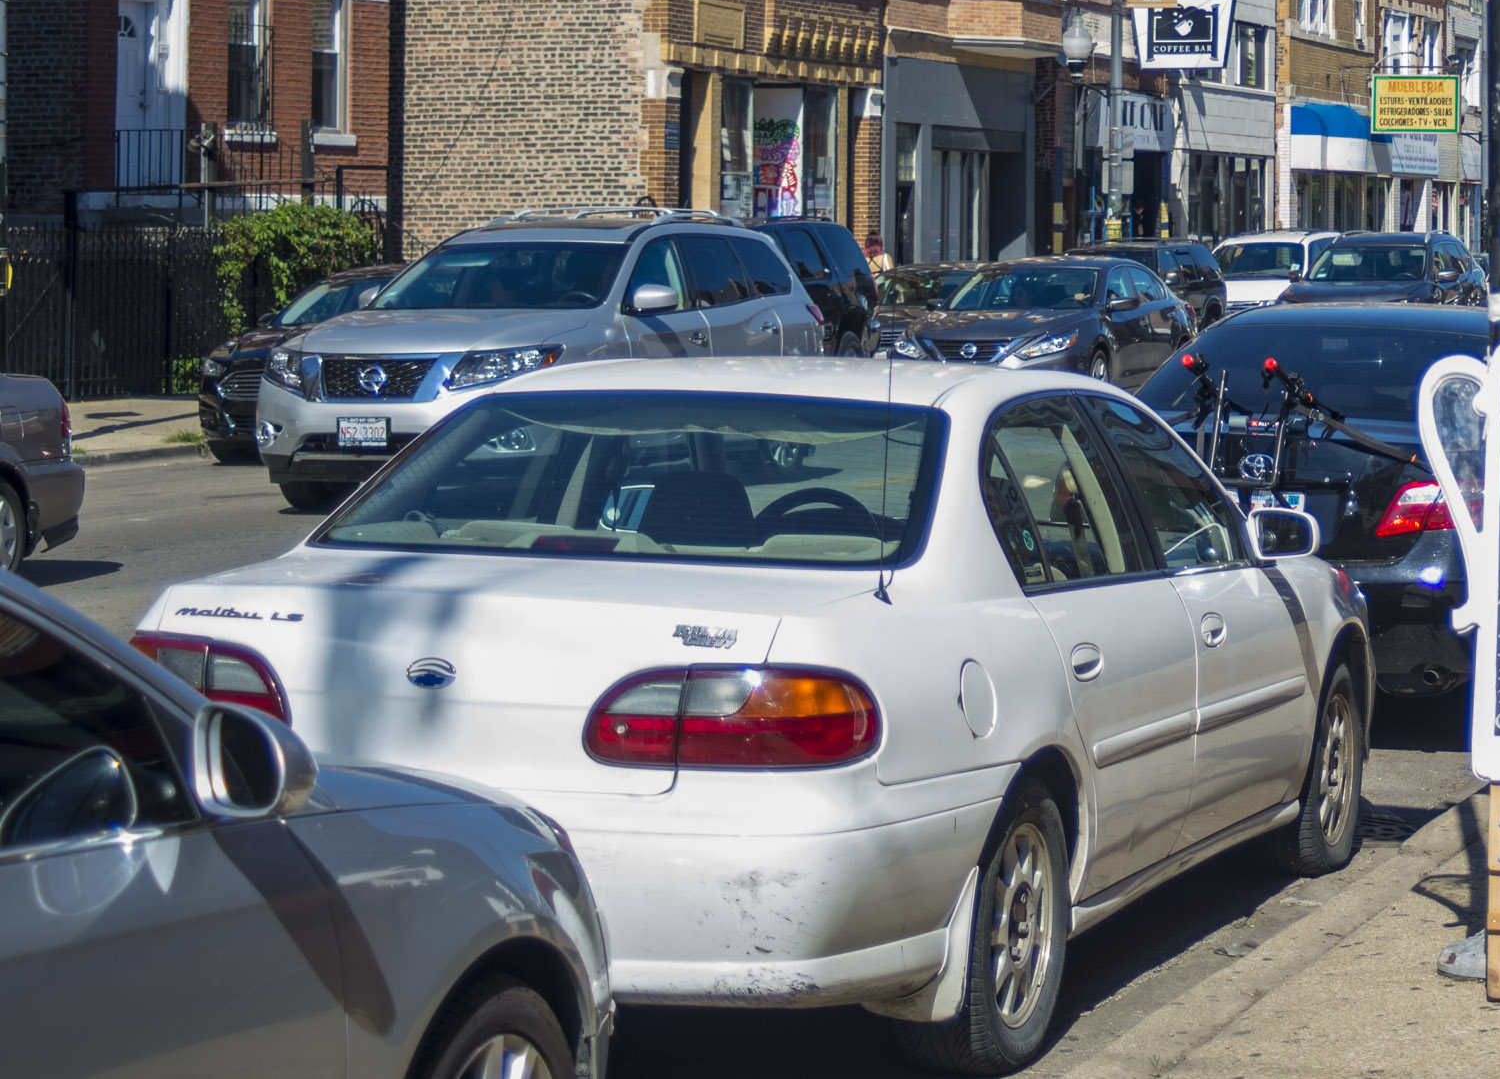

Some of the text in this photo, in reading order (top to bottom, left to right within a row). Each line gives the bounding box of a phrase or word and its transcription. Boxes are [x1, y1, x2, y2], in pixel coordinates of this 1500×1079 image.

[1153, 44, 1213, 53] COFFEE BAR
[1388, 81, 1445, 93] MUEBLERIA
[1380, 97, 1453, 105] ESTUFAS VENTILADORES
[1380, 107, 1453, 116] REFRIGERADORES SILLAS
[1380, 118, 1447, 127] COLCHONES TV VCR
[341, 426, 357, 440] N52
[175, 607, 304, 622] Malibu LS
